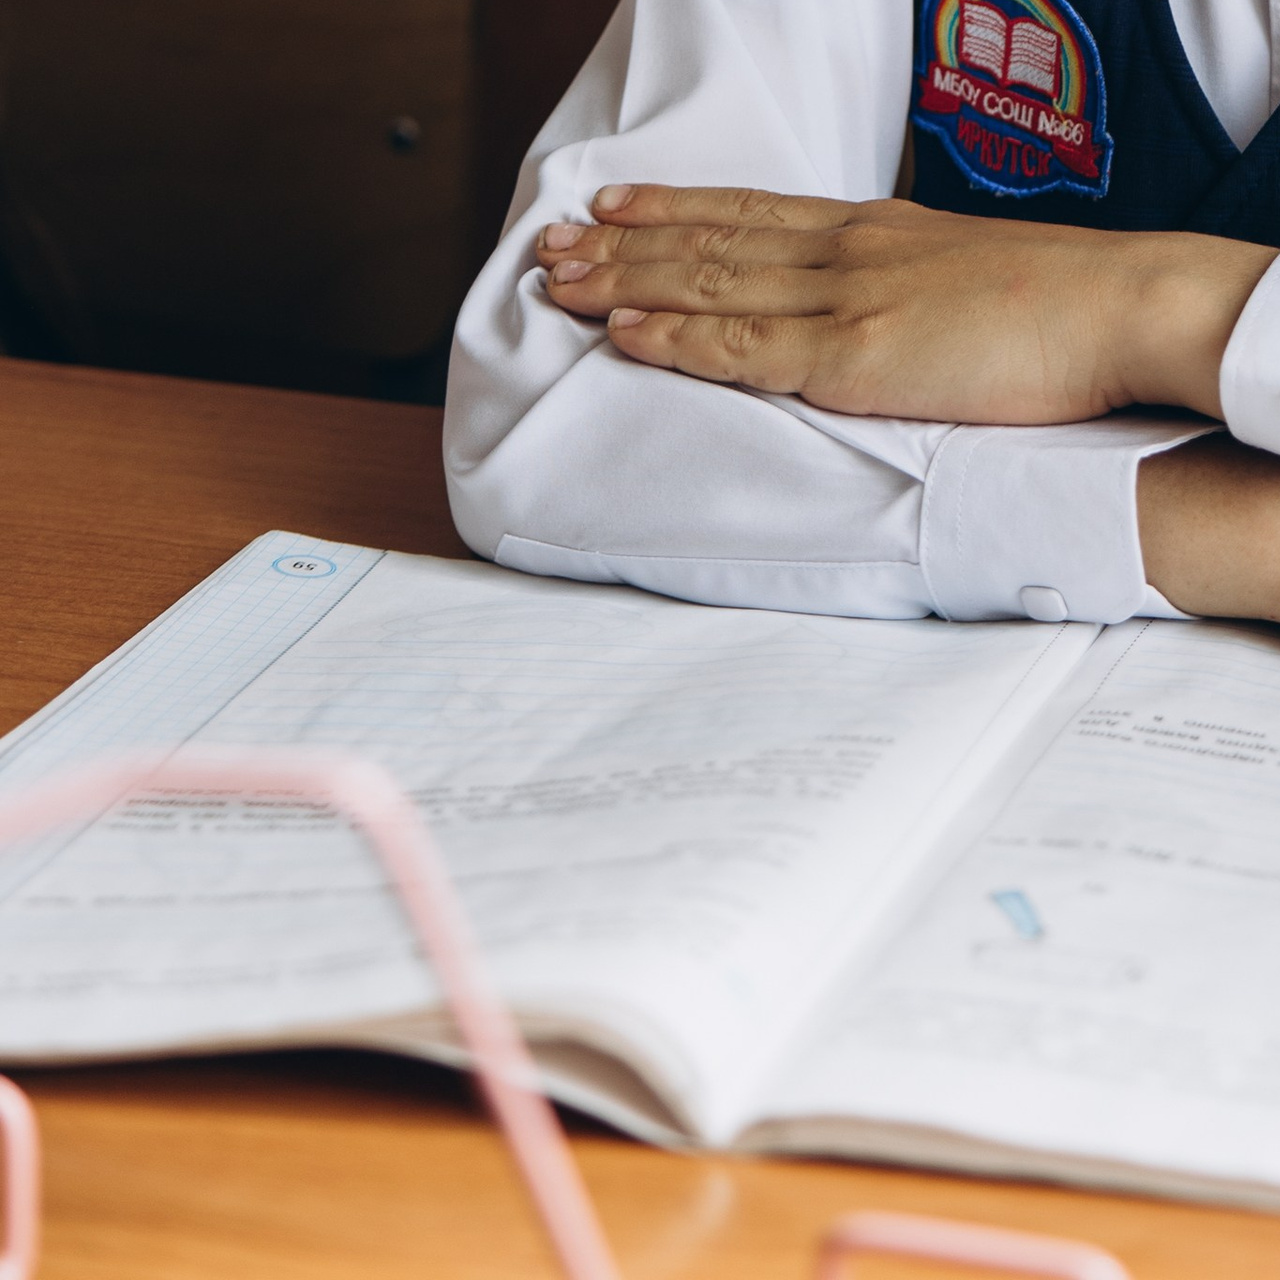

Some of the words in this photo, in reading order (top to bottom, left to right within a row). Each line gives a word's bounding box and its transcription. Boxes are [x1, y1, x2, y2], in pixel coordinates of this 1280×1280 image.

[933, 67, 981, 107] МБОУ
[982, 92, 1034, 130] СОШ
[957, 116, 1053, 178] ИРКУТСК
[291, 560, 318, 571] 59
